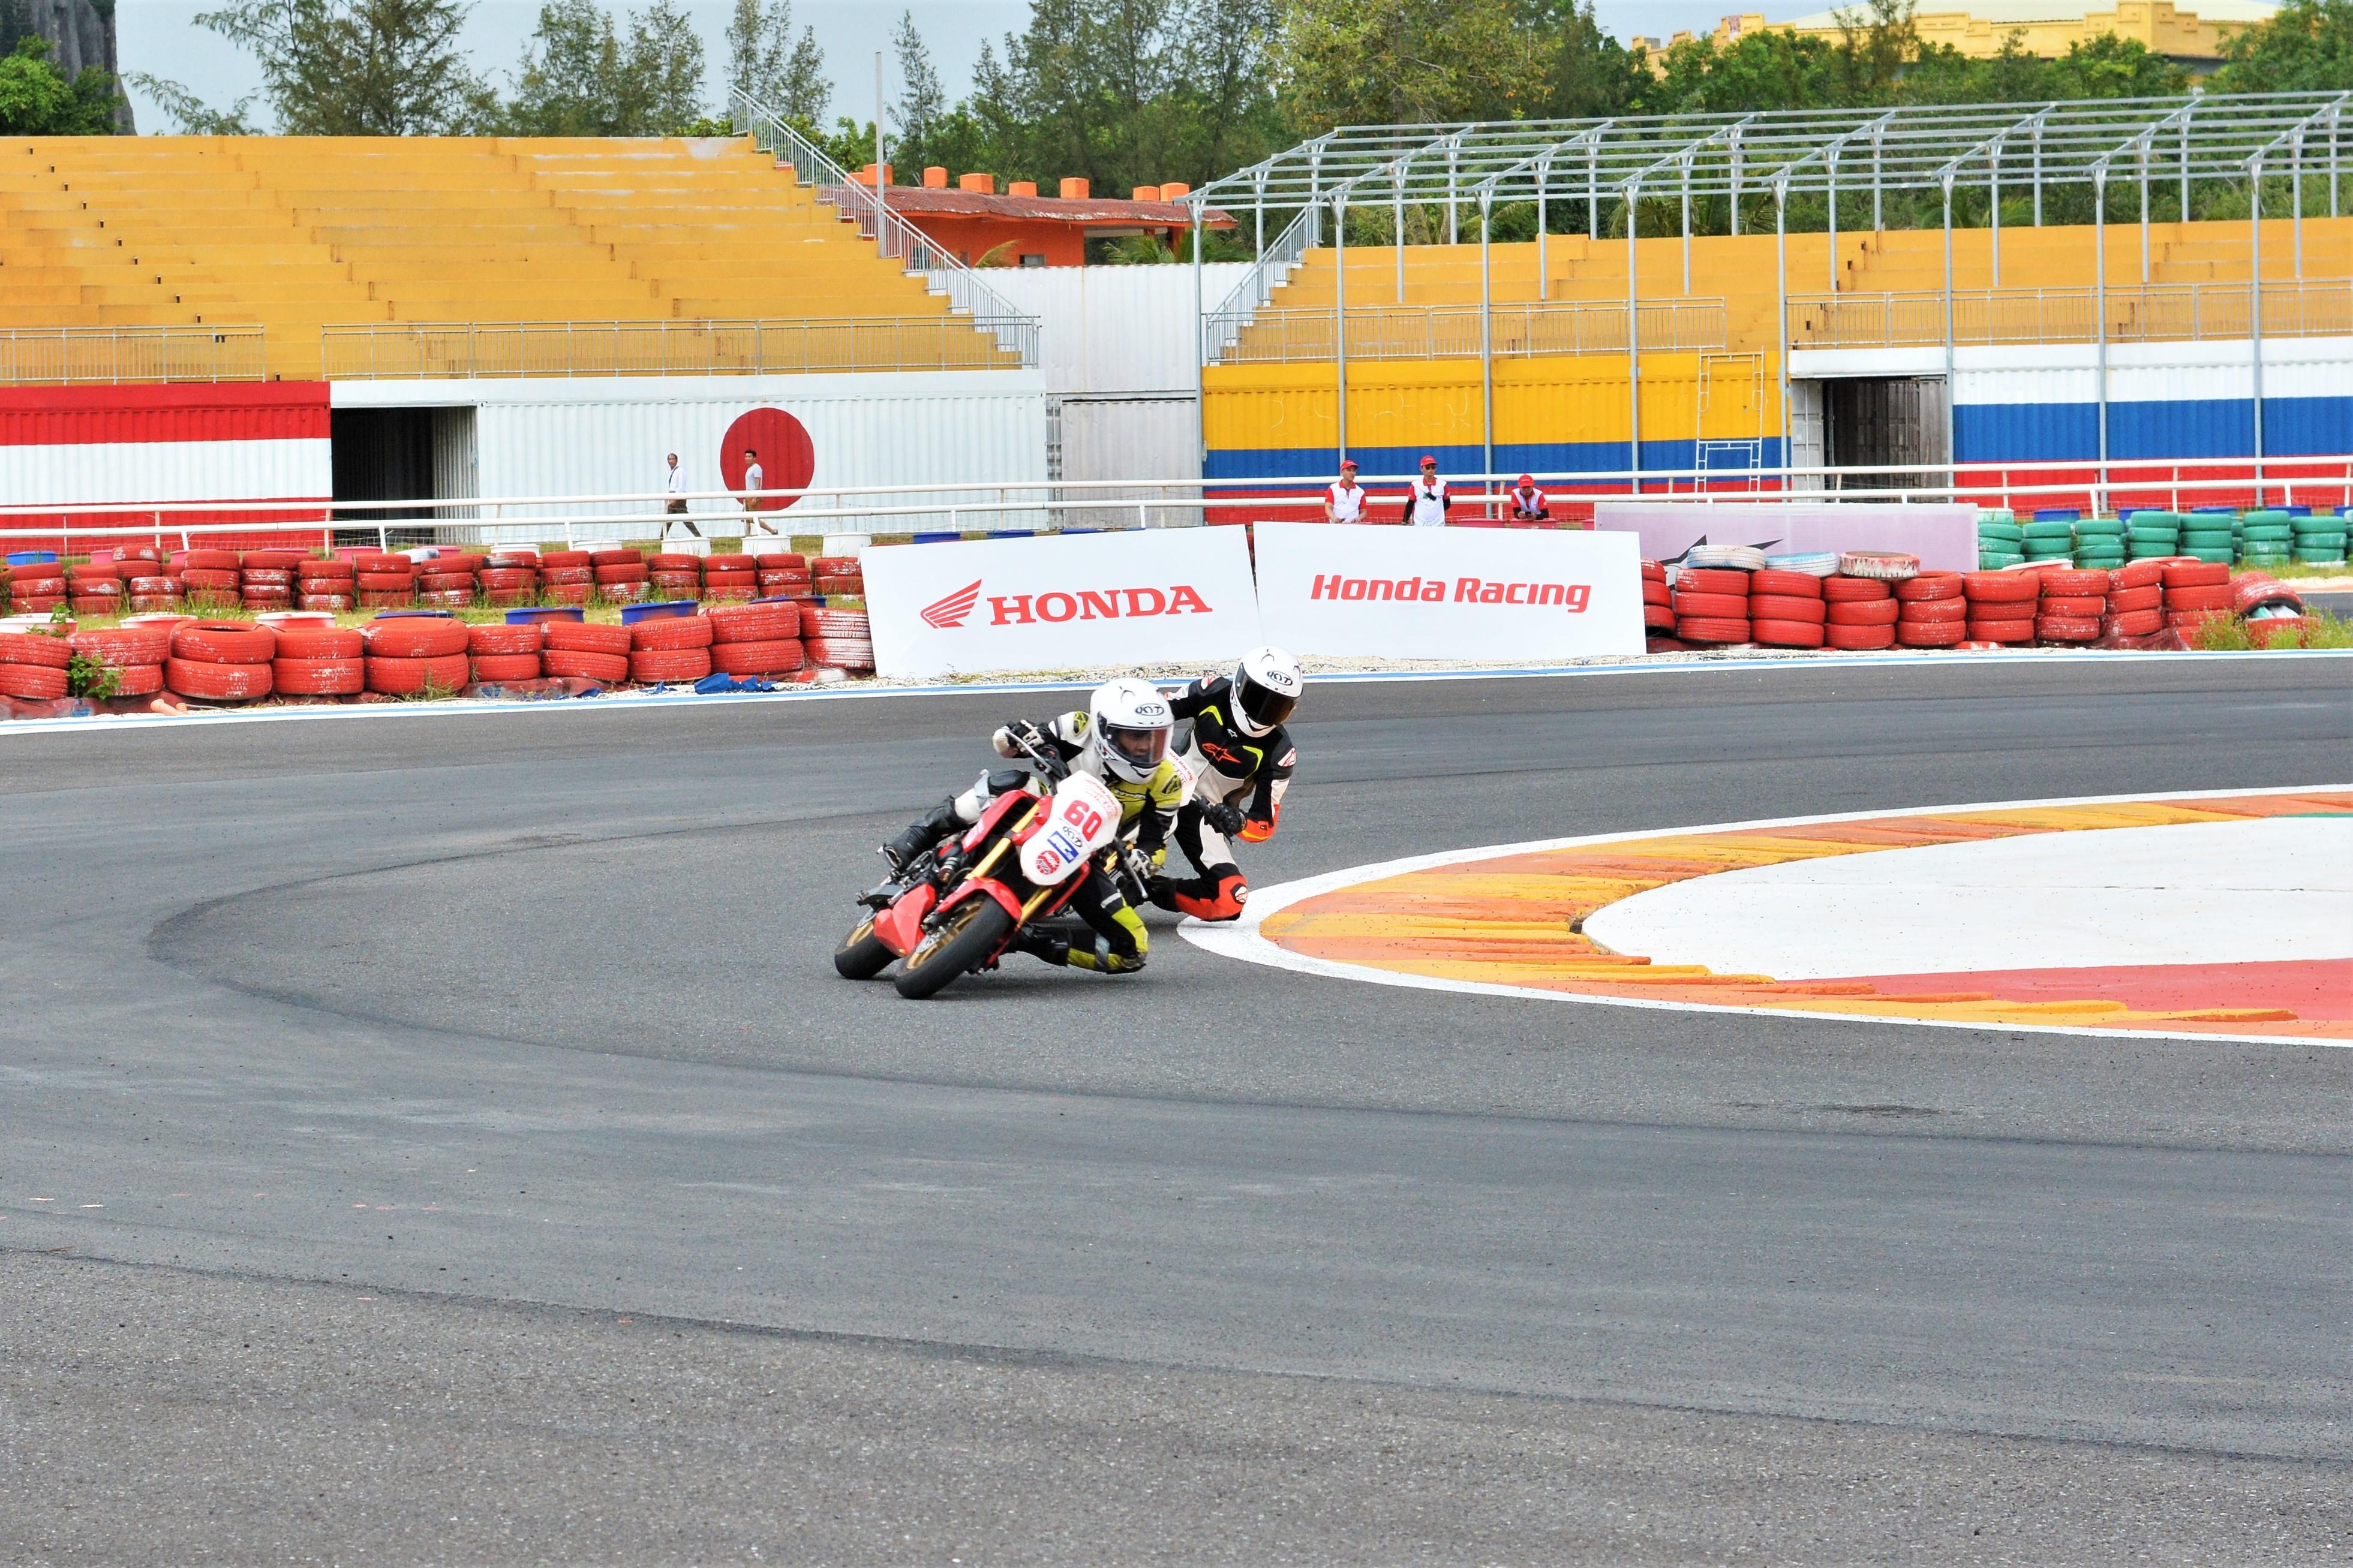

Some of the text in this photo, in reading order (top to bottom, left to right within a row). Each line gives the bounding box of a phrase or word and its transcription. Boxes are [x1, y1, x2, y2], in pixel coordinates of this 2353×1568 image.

[987, 585, 1213, 626] HONDA
[1311, 574, 1591, 613] Honda Racing
[1267, 671, 1292, 685] KYT
[1136, 705, 1163, 715] KYT
[1063, 800, 1102, 842] 60
[1062, 826, 1082, 847] KYT
